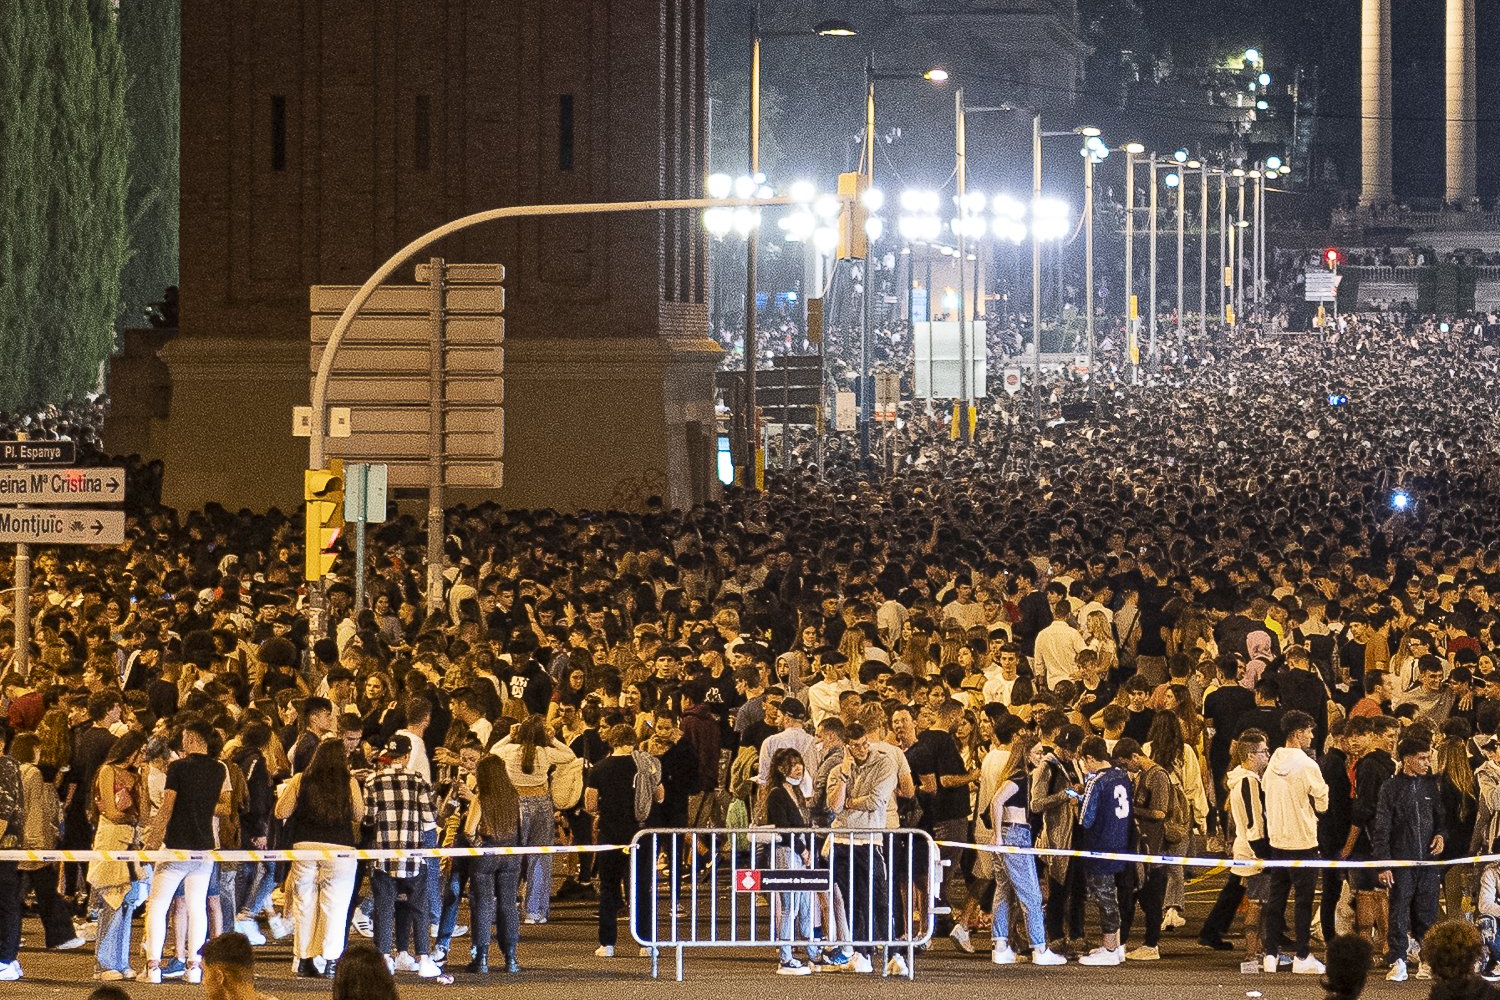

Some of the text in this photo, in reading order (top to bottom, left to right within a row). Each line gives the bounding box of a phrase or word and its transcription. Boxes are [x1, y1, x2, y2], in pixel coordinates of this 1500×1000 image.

[5, 445, 61, 460] Pl. Espanya
[0, 475, 27, 493] eina
[51, 474, 102, 493] Cristina
[0, 513, 63, 537] Montjuïc
[1113, 784, 1130, 819] 3
